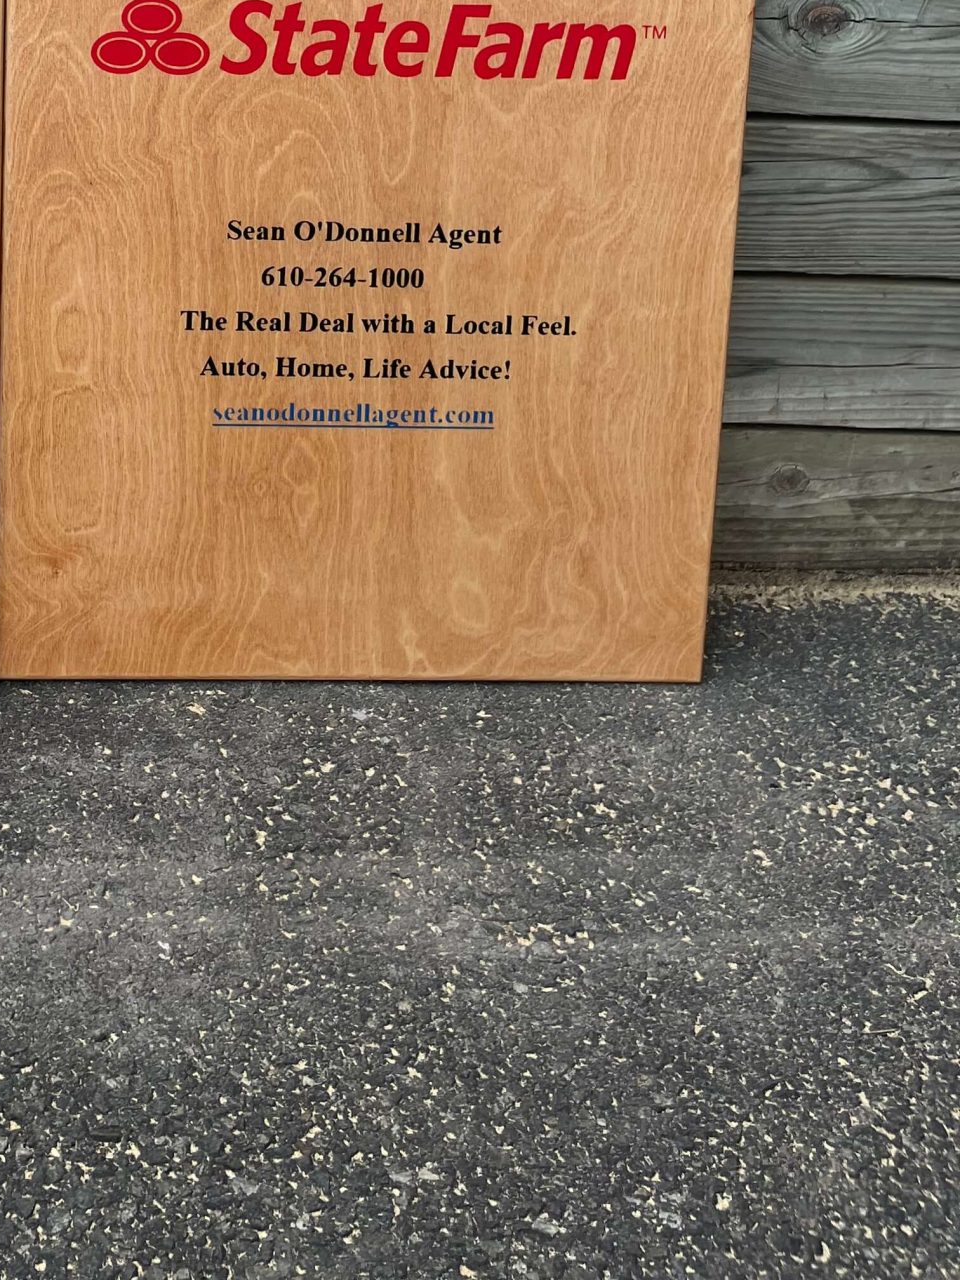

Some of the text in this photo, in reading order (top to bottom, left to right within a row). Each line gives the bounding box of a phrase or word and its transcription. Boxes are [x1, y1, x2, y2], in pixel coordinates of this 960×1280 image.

[228, 220, 502, 249] Sean O'Donnell Agent
[262, 266, 424, 288] 610-264-1000
[181, 311, 576, 335] The Real Deal with a Local Feel.
[200, 356, 510, 381] Auto, Home, Life Advice!
[213, 403, 493, 428] seanodonnellagent.com
